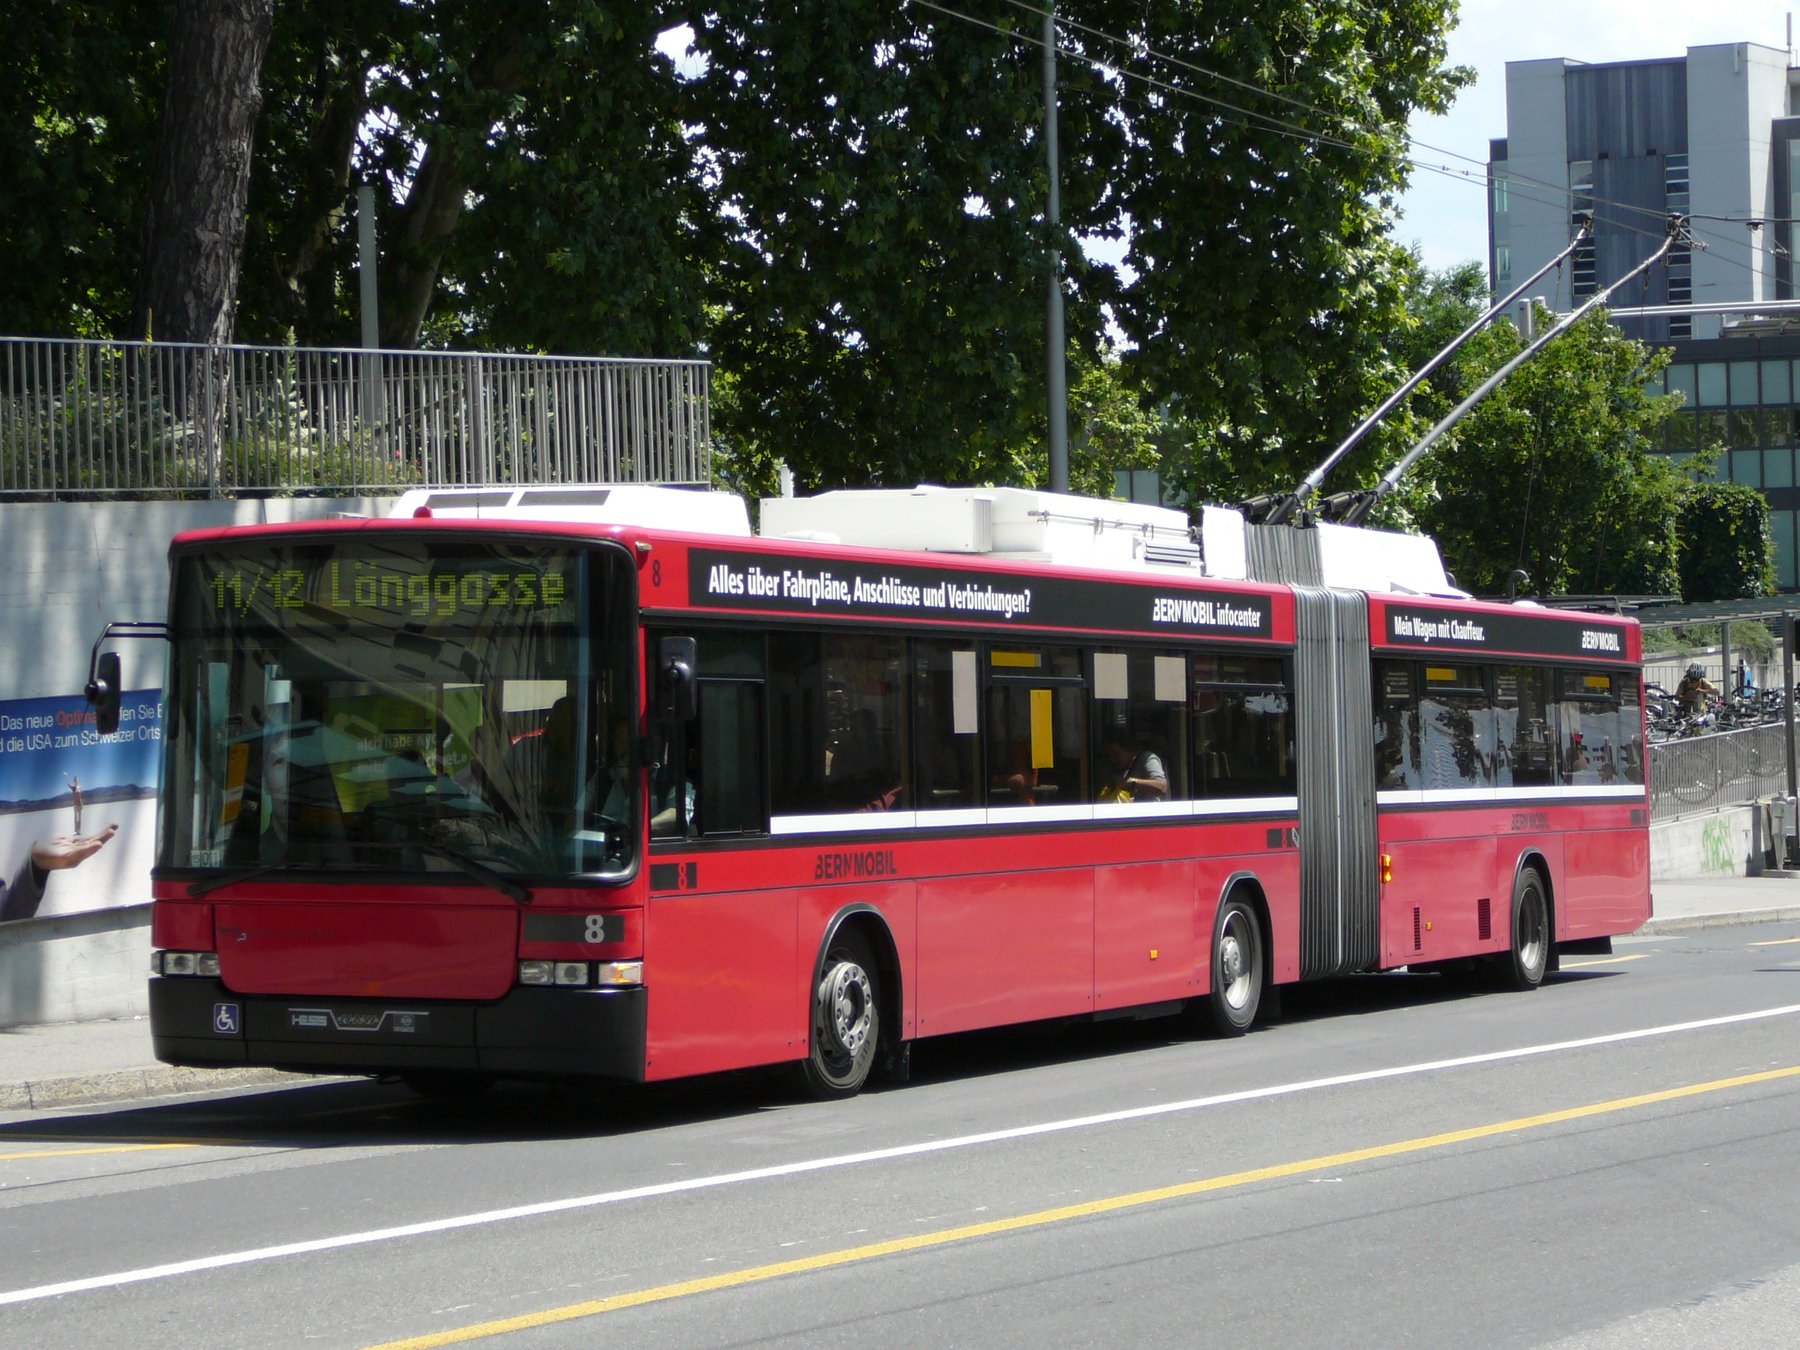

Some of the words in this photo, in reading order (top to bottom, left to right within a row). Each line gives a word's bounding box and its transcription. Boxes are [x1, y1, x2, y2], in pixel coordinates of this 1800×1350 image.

[652, 559, 661, 588] 8
[210, 567, 305, 618] 11/12
[708, 564, 744, 594] Alles
[747, 567, 779, 597] über
[783, 570, 852, 606] Fahrpläne,
[853, 575, 920, 606] Anschlüsse
[923, 581, 946, 608] und
[947, 583, 1031, 619] Verbindungen?
[1216, 602, 1261, 628] infocenter
[1394, 616, 1413, 636] Mein
[1413, 617, 1437, 642] Wagen
[1438, 618, 1450, 639] mit
[1451, 619, 1485, 641] Chauffeur.
[1, 715, 24, 731] Das
[26, 714, 54, 729] neue
[138, 703, 155, 720] Sie
[7, 736, 24, 752] die
[27, 733, 53, 751] USA
[55, 734, 78, 749] zum
[678, 862, 688, 890] 8
[584, 914, 605, 943] 8
[291, 1014, 328, 1027] HESS
